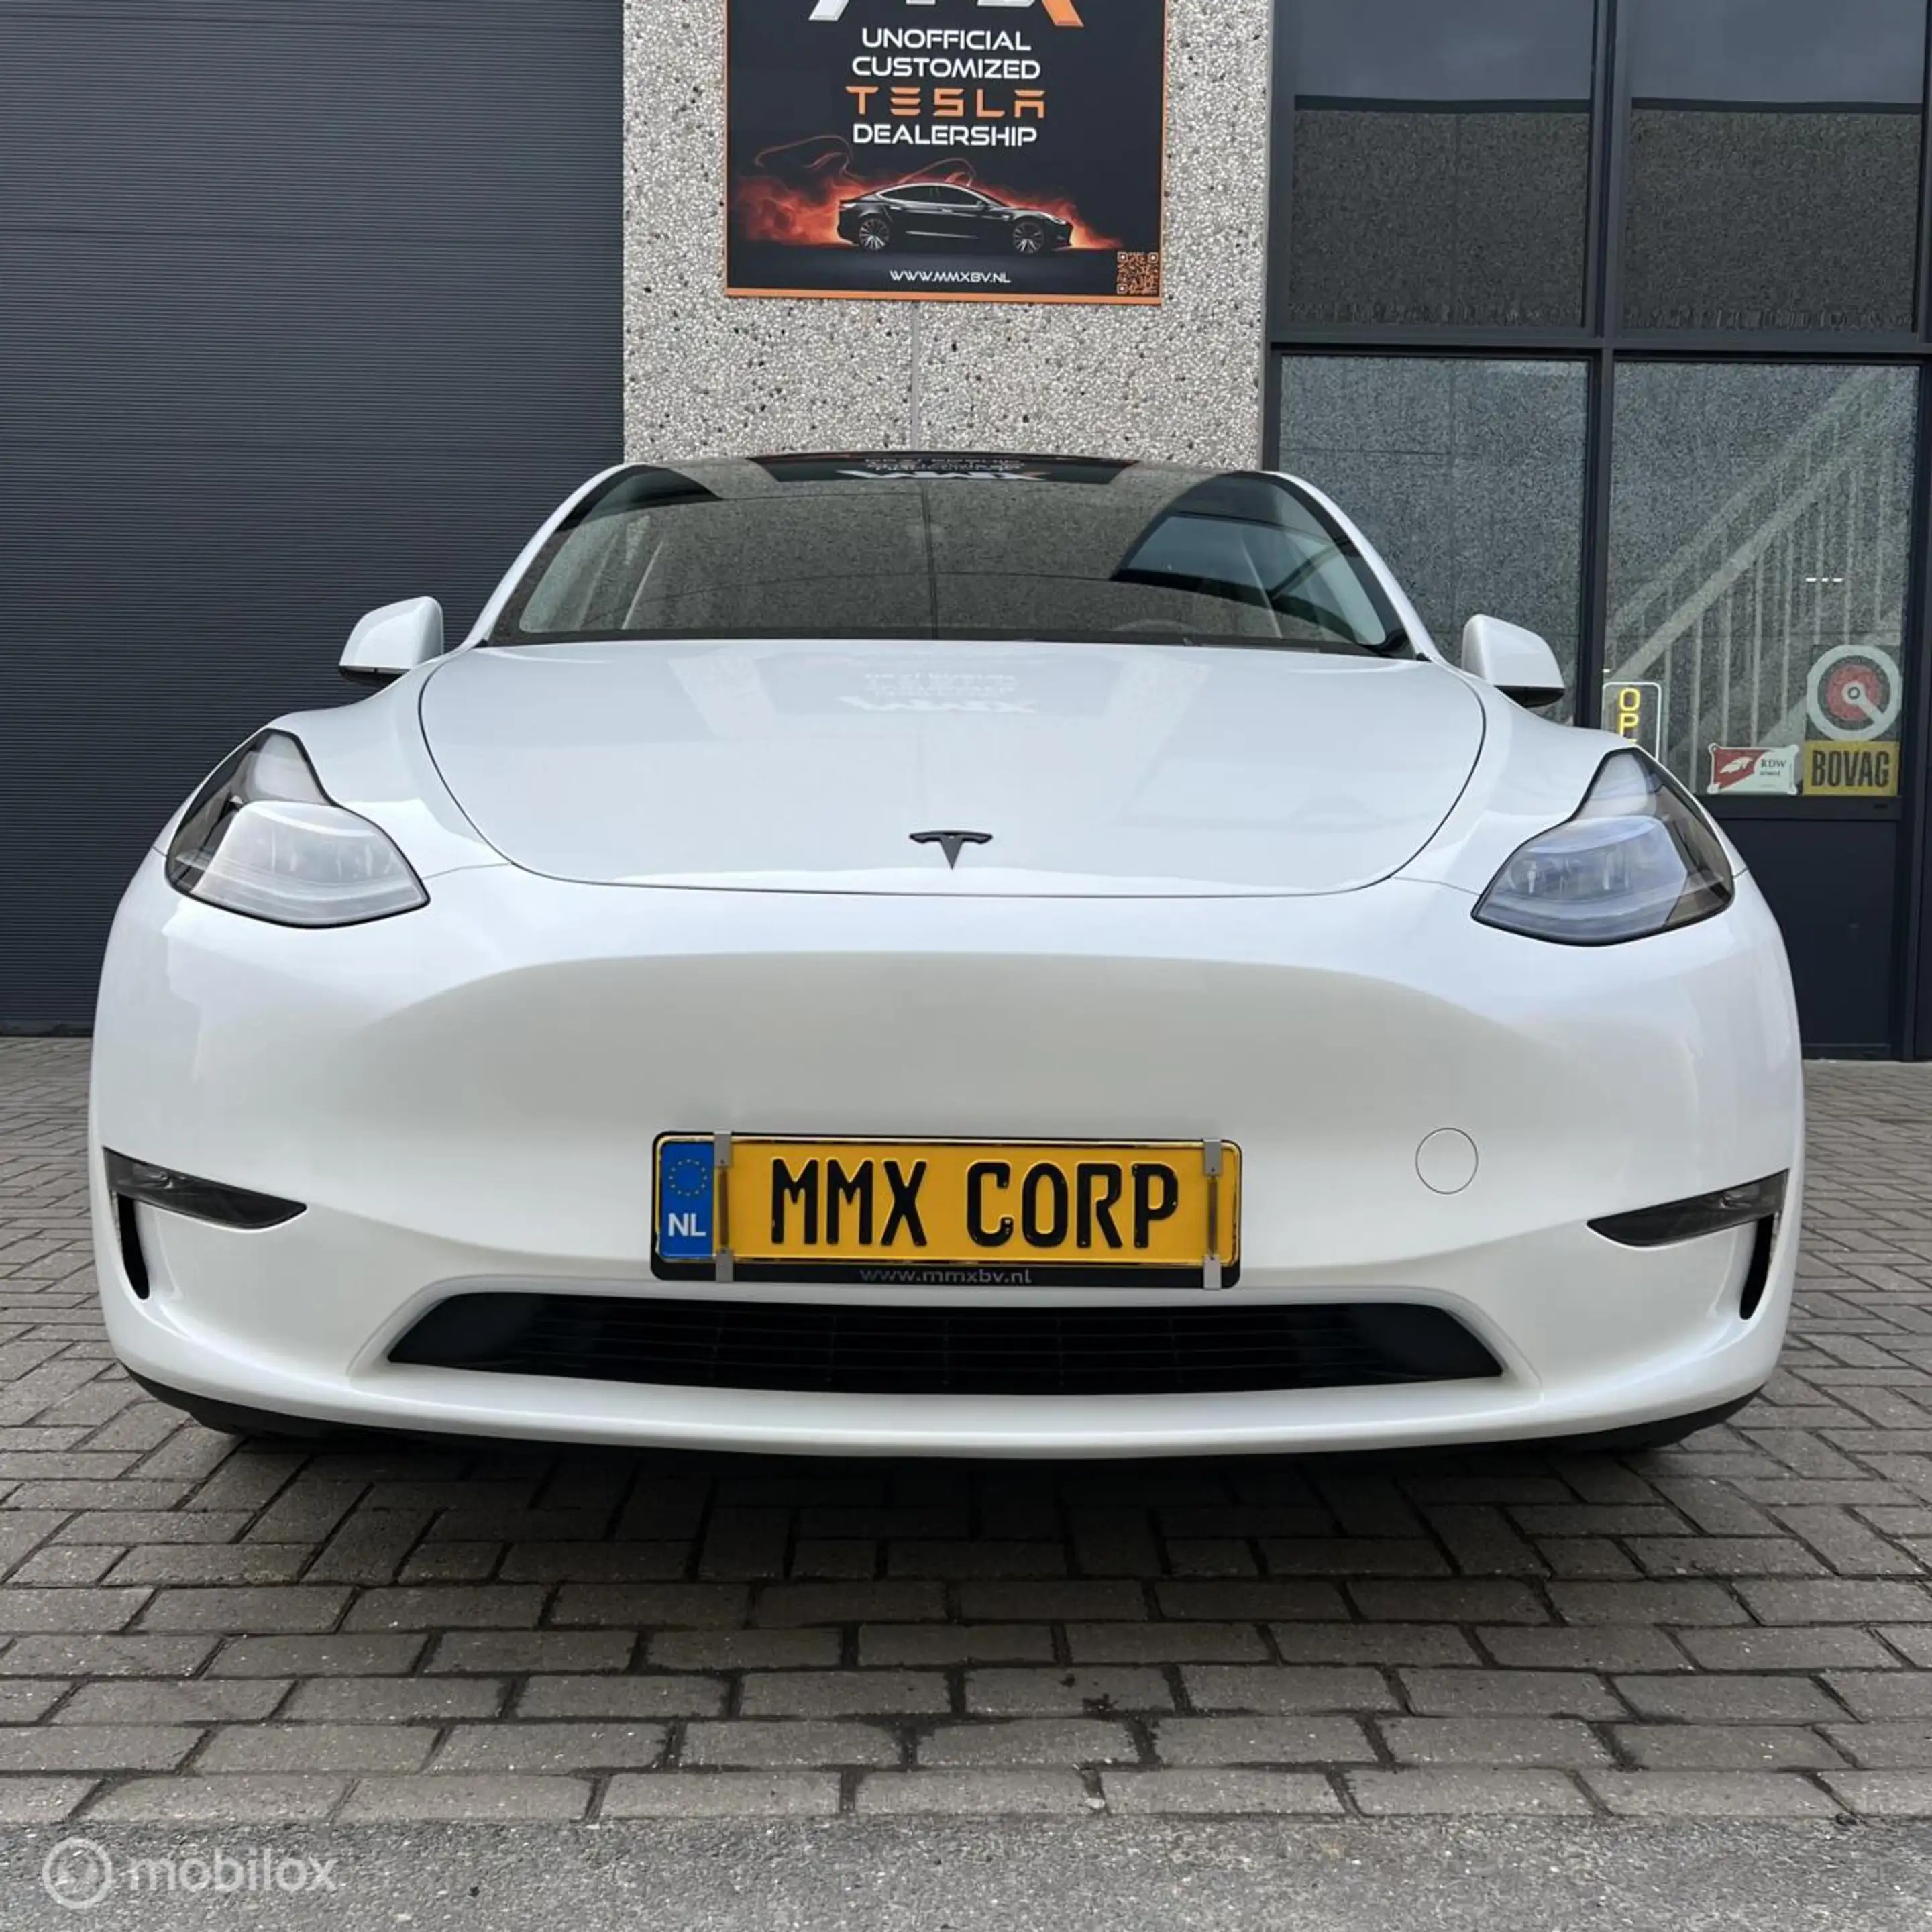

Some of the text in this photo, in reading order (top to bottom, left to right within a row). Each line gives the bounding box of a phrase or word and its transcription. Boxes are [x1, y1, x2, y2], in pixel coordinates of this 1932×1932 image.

[861, 27, 1032, 52] UNOFFICIAL
[851, 56, 1042, 80] CUSTOMIZED
[845, 85, 1046, 119] TESLA
[852, 123, 1038, 147] DEALERSHIP
[889, 270, 1012, 284] WWW.MMXBV.NL
[1619, 687, 1641, 745] OP
[1811, 749, 1890, 788] BOVAG
[771, 1156, 1180, 1249] MMX CORP
[667, 1212, 707, 1238] NL
[859, 1268, 1032, 1284] www.mmxbv.nl
